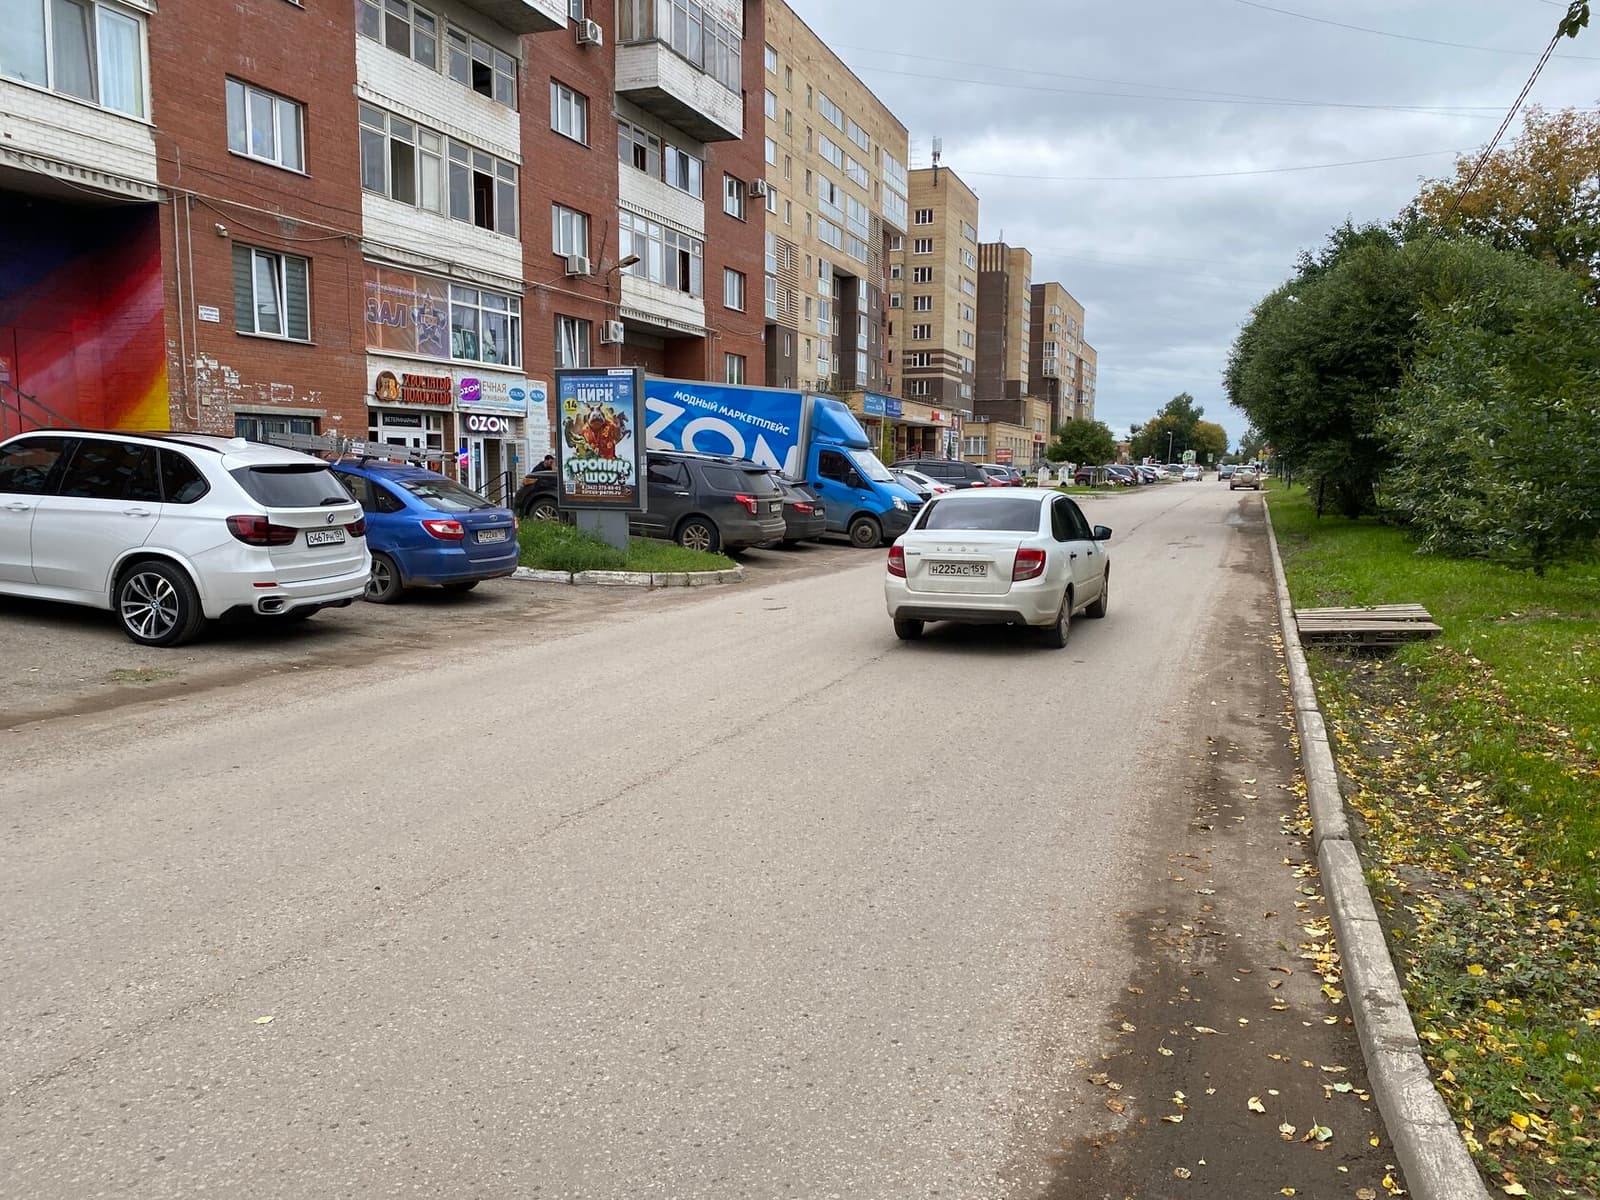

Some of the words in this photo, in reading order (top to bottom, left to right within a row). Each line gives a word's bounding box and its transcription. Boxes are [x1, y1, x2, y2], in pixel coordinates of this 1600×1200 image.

[367, 297, 408, 328] ЗАЛ
[482, 381, 507, 393] ЕЧНАЯ
[577, 388, 614, 404] ЦИРК
[674, 390, 718, 412] МОДНЫЙ
[719, 405, 791, 436] МАРКЕТПЛЕЙС
[469, 415, 509, 432] OZON
[569, 459, 631, 475] ТРОПИК
[585, 471, 618, 484] ШОУ
[931, 564, 969, 575] Н225АС
[970, 564, 985, 573] 159
